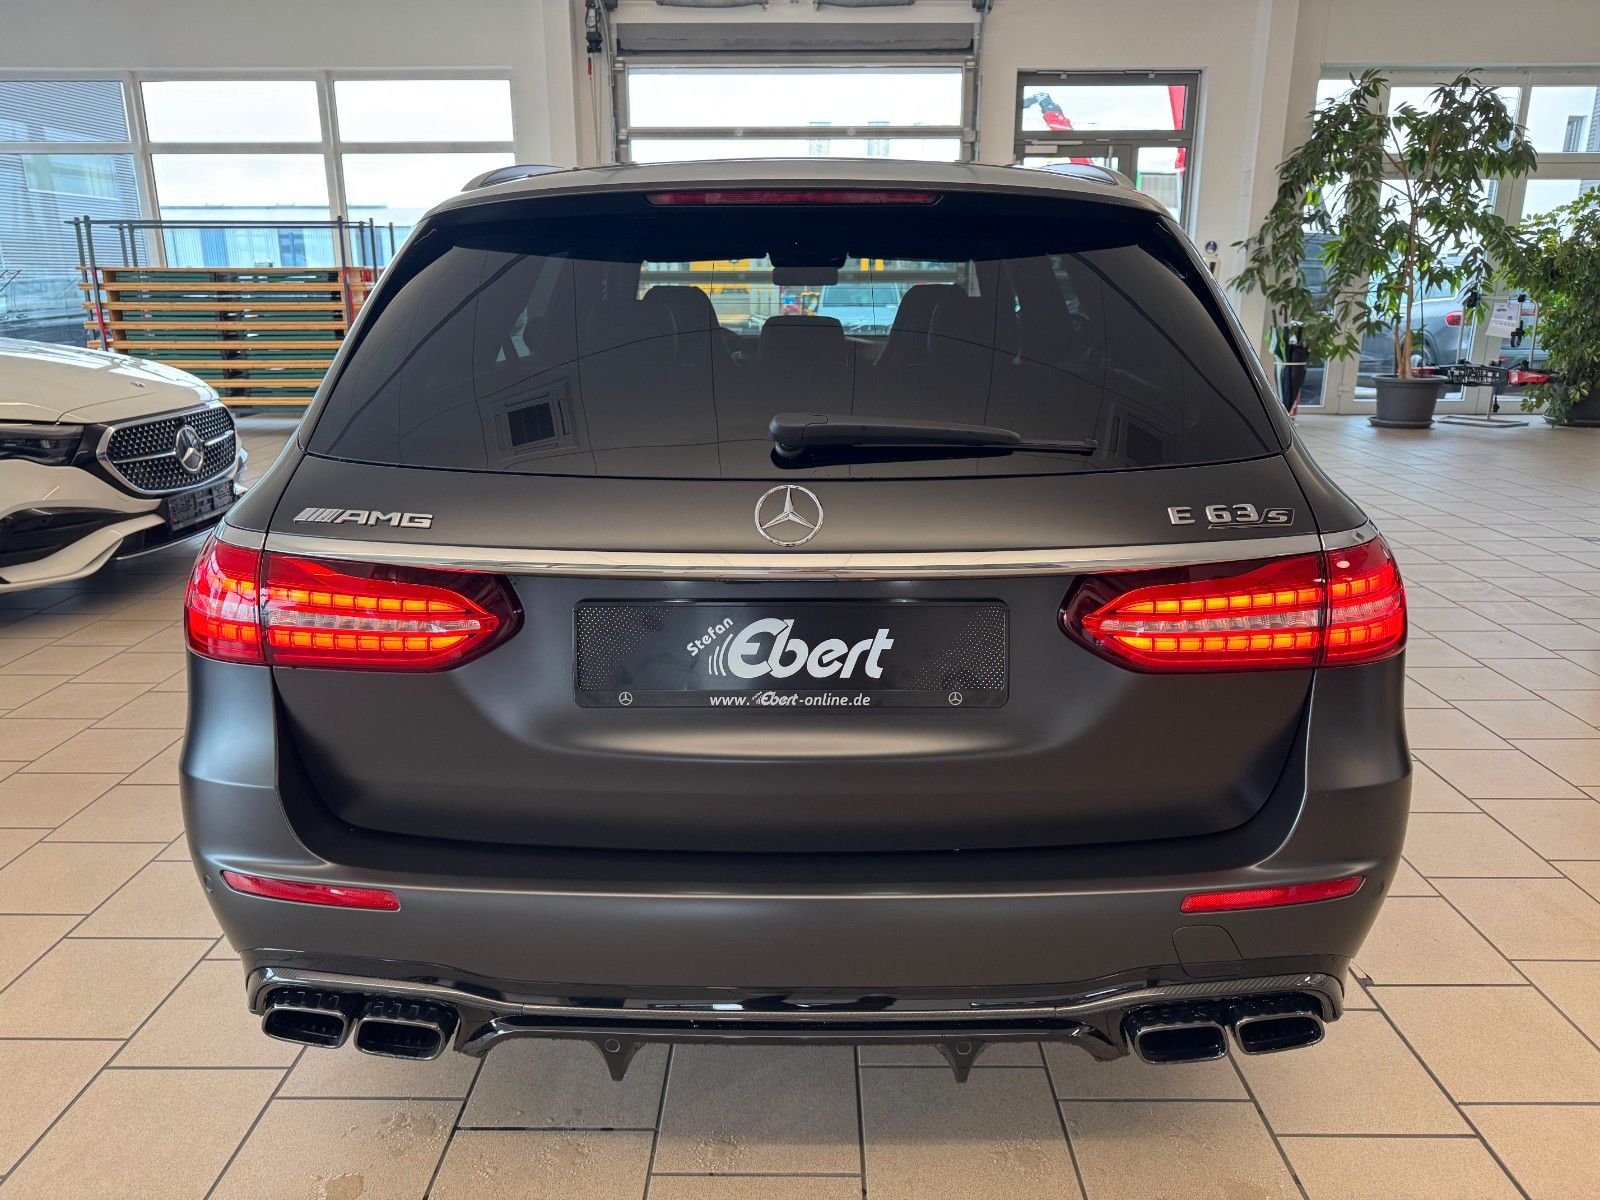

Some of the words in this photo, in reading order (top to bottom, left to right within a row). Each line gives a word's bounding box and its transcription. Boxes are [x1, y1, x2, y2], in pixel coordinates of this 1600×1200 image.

[333, 509, 434, 529] AMG
[1167, 506, 1196, 525] E
[1205, 503, 1261, 524] 63
[686, 616, 735, 657] Stefan
[727, 617, 895, 679] Ebert
